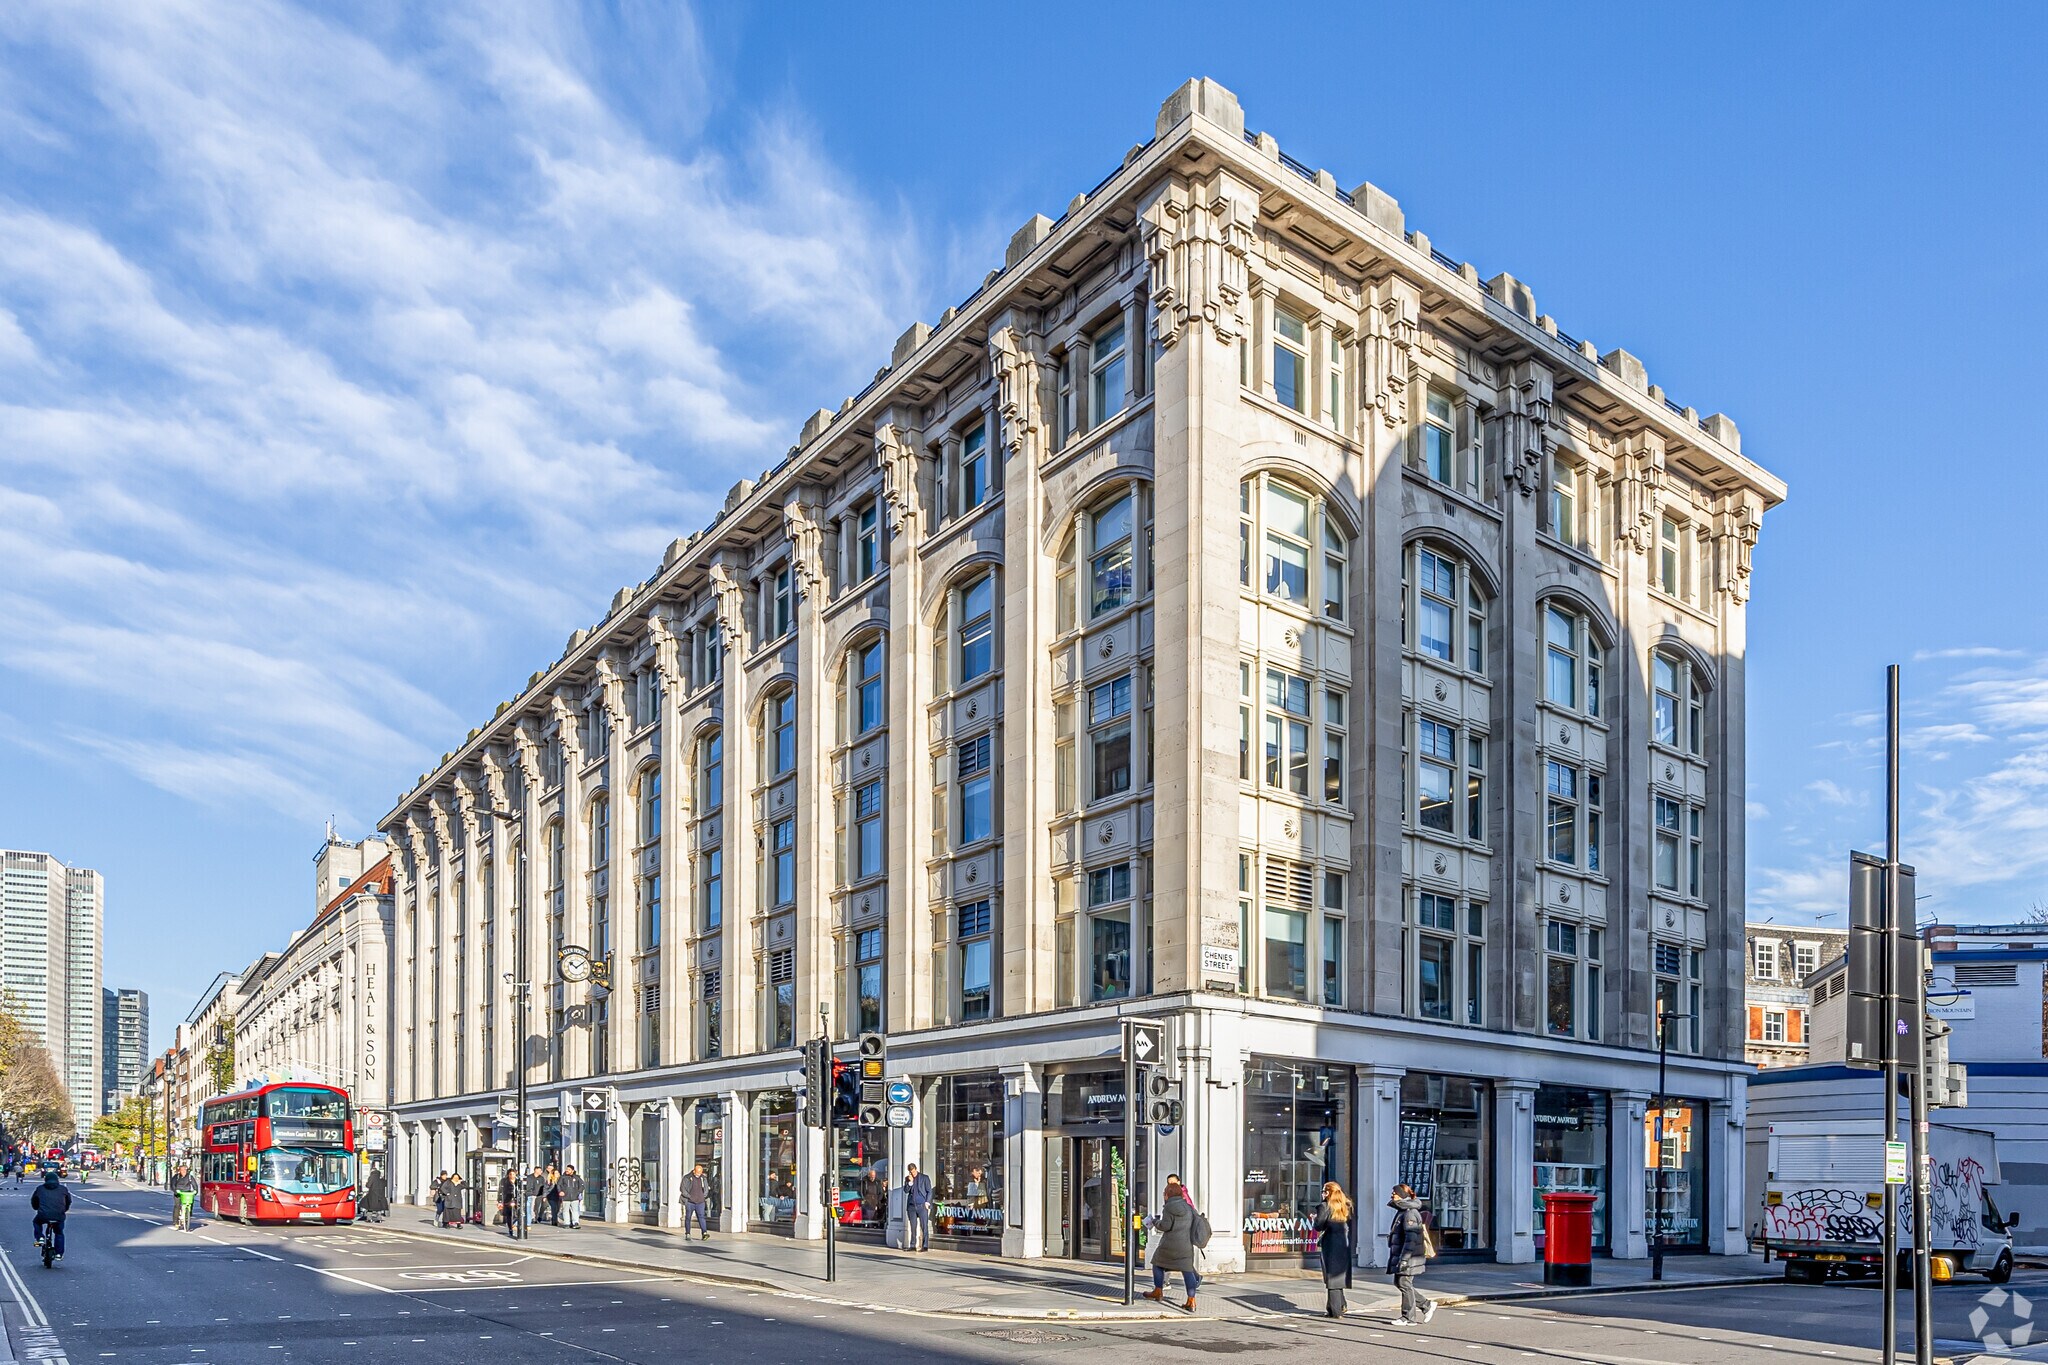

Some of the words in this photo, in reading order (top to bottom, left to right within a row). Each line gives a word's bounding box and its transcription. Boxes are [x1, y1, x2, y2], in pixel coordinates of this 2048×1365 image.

[1204, 951, 1233, 962] CHENIES
[1204, 960, 1230, 970] STREET
[365, 963, 376, 1018] HEAL
[366, 1024, 376, 1035] &
[365, 1040, 376, 1081] SON
[1088, 1094, 1118, 1104] ANDREW
[1557, 1116, 1578, 1124] MARTIN
[296, 1130, 306, 1138] Court
[324, 1130, 338, 1140] 29
[935, 1206, 970, 1218] ANDREW
[971, 1207, 1003, 1220] MARTIN
[1243, 1217, 1297, 1231] ANDREW
